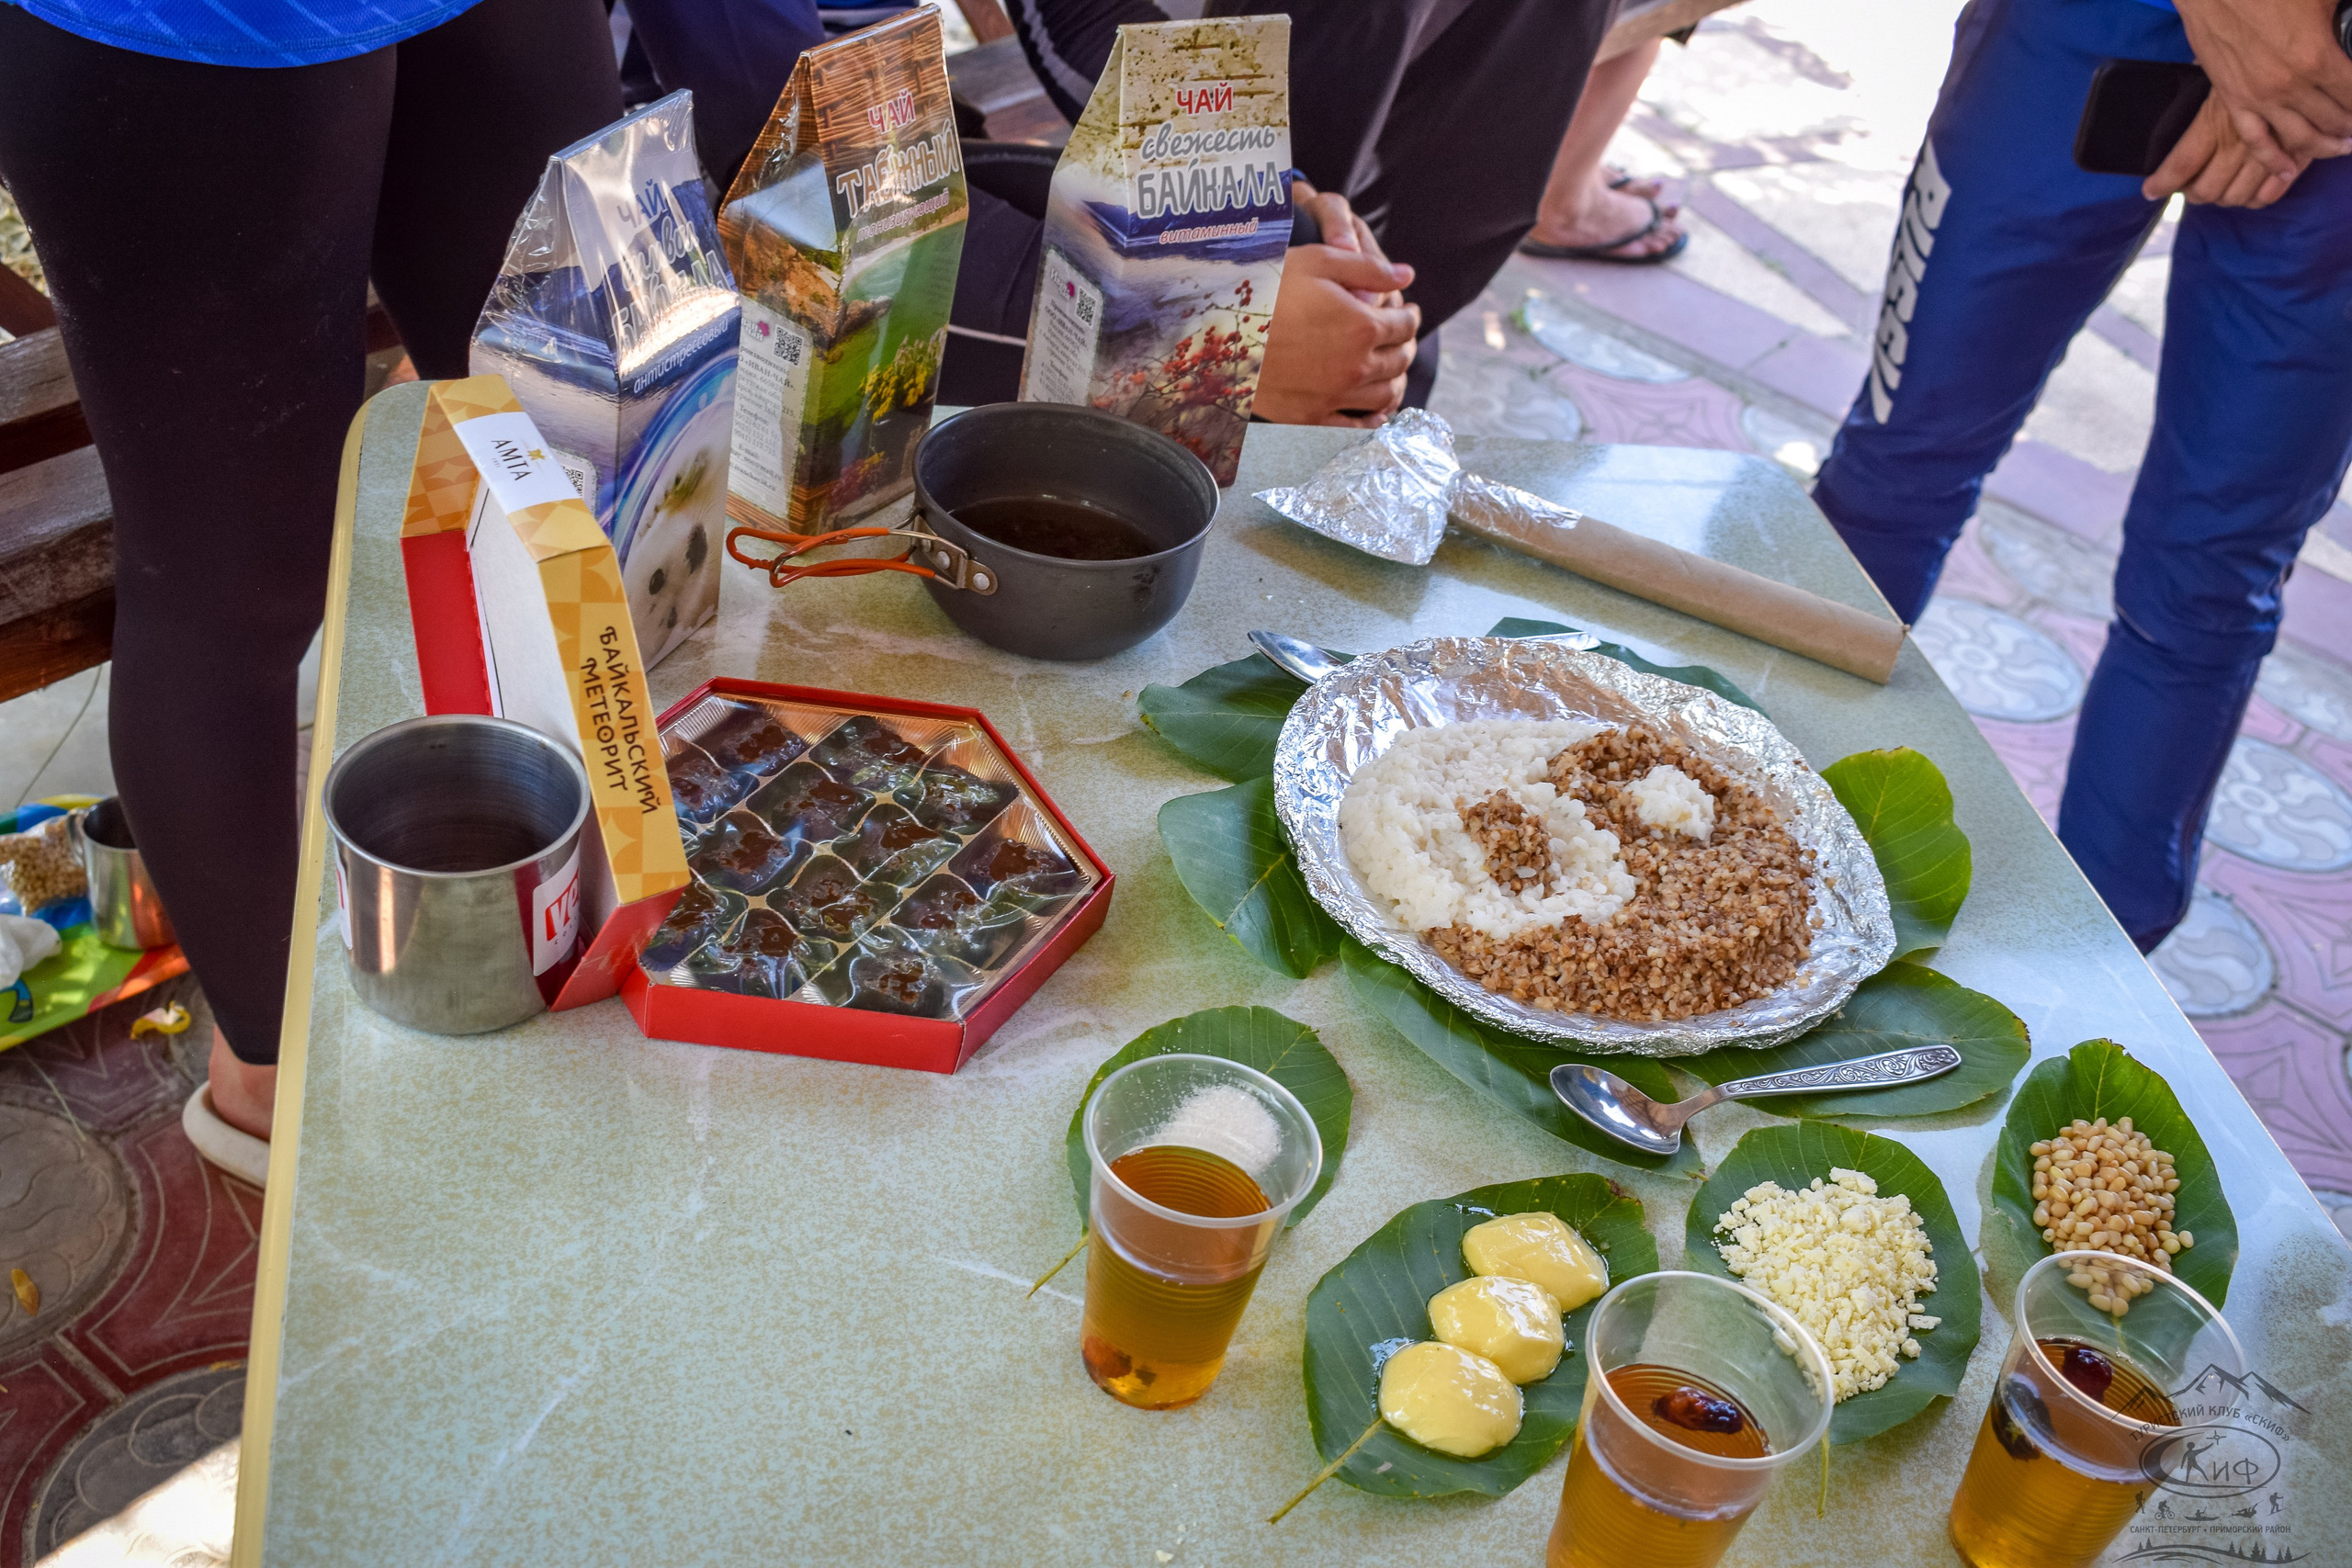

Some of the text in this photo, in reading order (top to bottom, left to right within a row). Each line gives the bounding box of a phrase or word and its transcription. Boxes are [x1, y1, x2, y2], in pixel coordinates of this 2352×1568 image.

[866, 88, 917, 134] ЧАЙ
[1175, 82, 1234, 116] ЧАЙ
[1140, 121, 1276, 161] свежесть
[616, 178, 668, 229] ЧАЙ
[1136, 157, 1286, 219] БАЙКАЛА
[856, 187, 950, 243] тонизирующий
[1159, 217, 1260, 245] витаминный
[740, 344, 790, 377] роизводитель:
[490, 439, 533, 481] АМТА
[580, 657, 629, 792] МЕТЕОРИТ
[599, 626, 662, 815] БАЙКАЛЬСКИЙ
